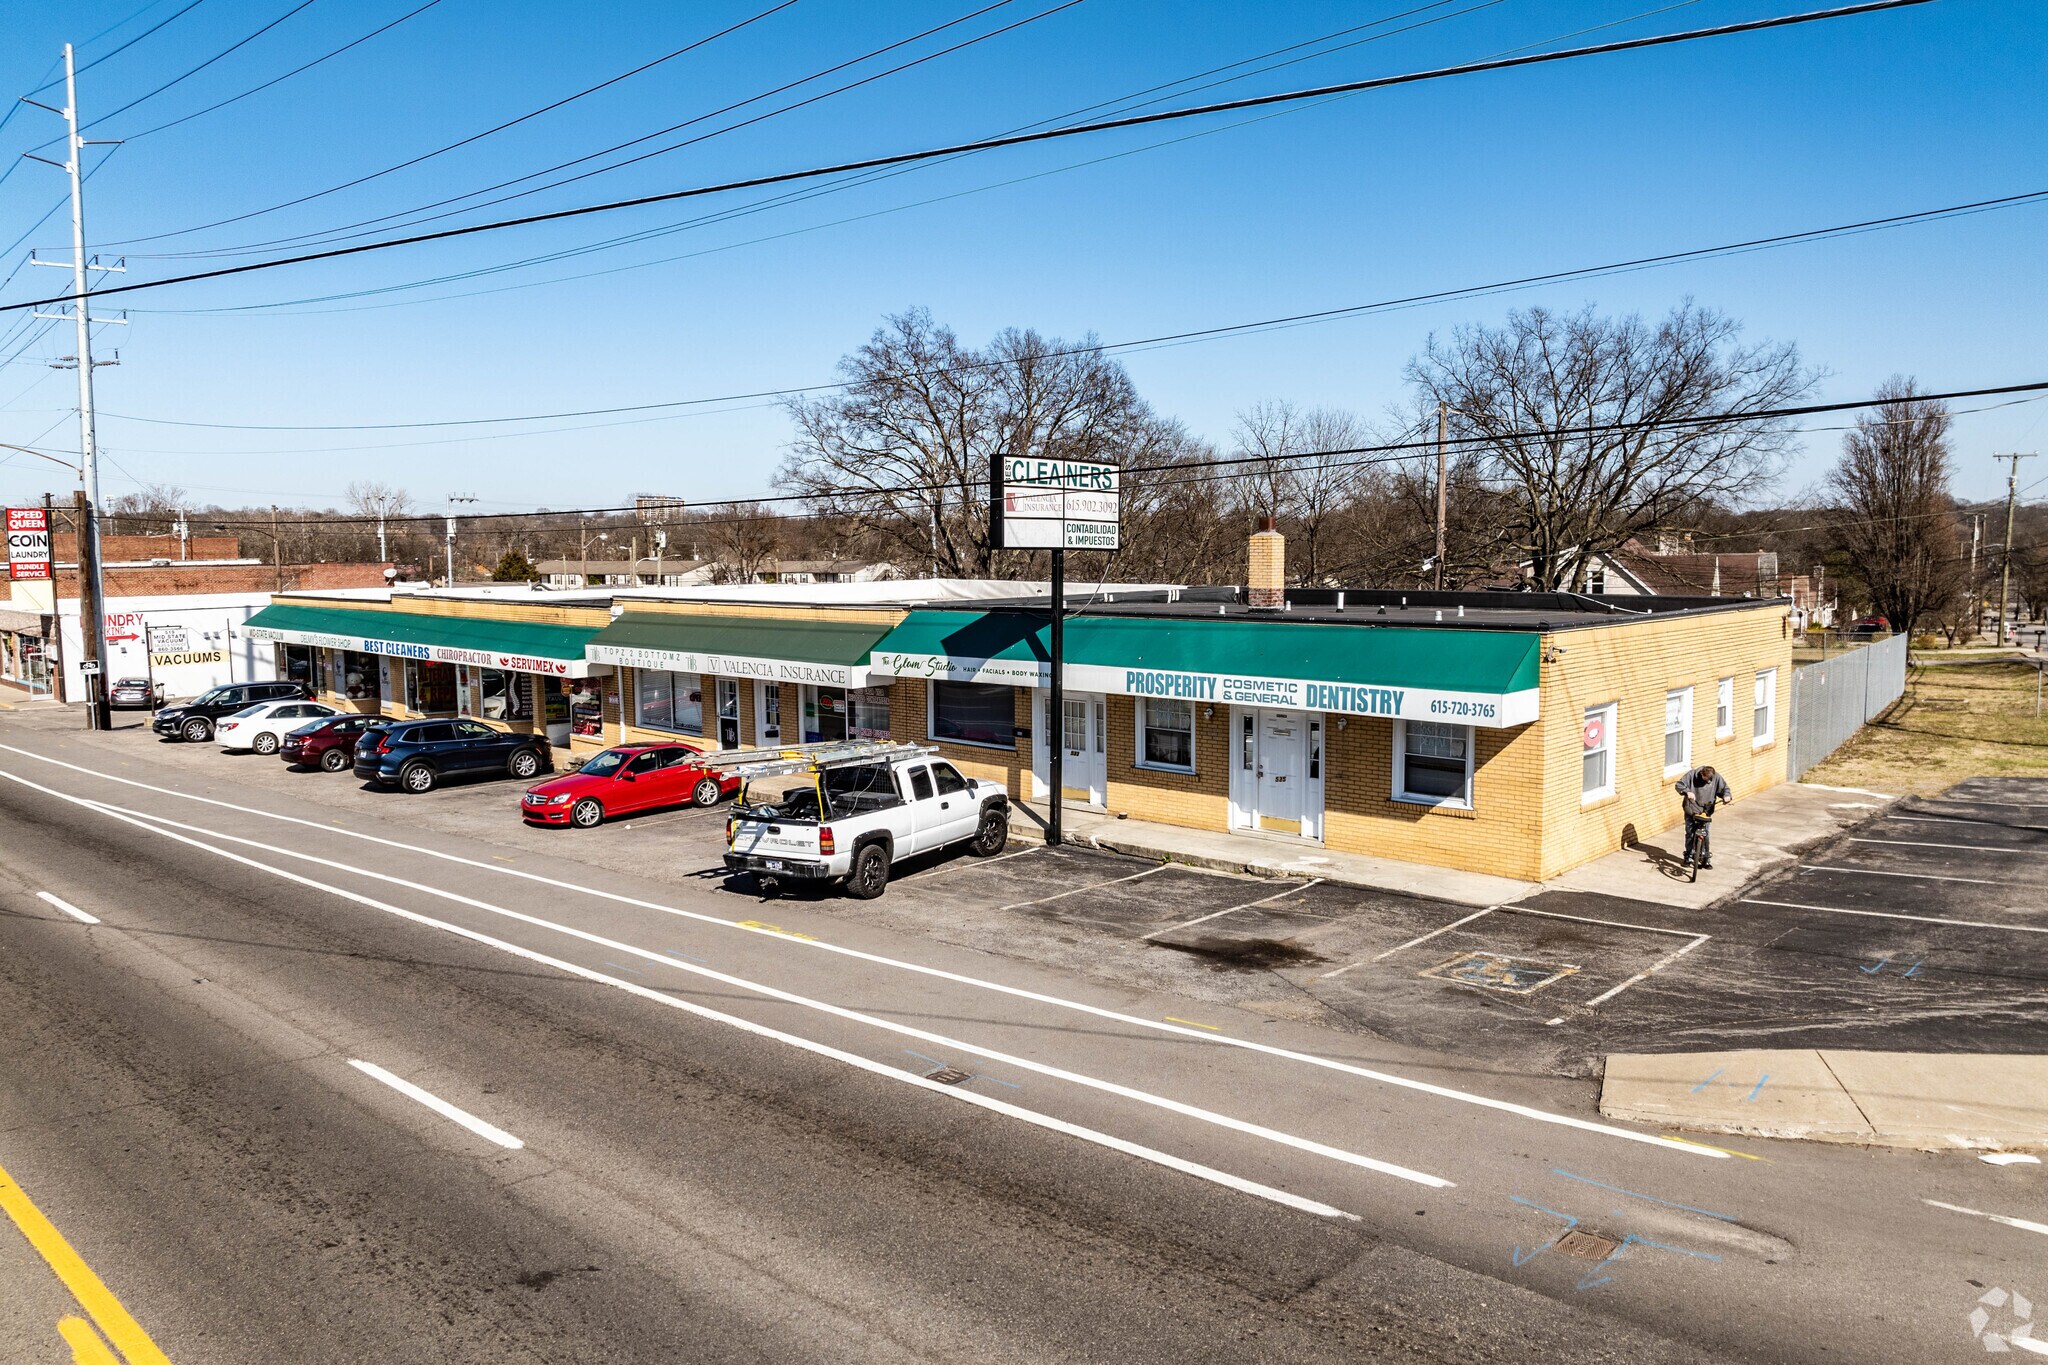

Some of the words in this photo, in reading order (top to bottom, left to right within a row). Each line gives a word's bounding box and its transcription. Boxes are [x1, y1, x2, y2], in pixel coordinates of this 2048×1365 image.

[1012, 460, 1112, 489] CLEANERS
[1024, 503, 1062, 512] INSURANCE
[1066, 499, 1118, 514] 615.902.3092
[11, 510, 43, 519] SPEED
[9, 519, 46, 529] QUEEN
[1066, 523, 1116, 535] CONTABILIDAD
[9, 535, 48, 547] COIN
[1075, 536, 1115, 546] IMPUESTOS
[104, 614, 143, 627] NDRY
[105, 627, 125, 636] KING
[154, 651, 221, 666] VACUUMS
[268, 630, 284, 640] VACUUM
[318, 637, 337, 647] FLOWER
[337, 638, 352, 648] SHOP
[364, 640, 384, 653] BEST
[386, 642, 430, 660] CLEANERS
[436, 648, 492, 665] CHIROPRACTOR
[511, 656, 554, 673] SERVIMEX
[604, 647, 625, 656] TOPZ
[629, 649, 633, 657] 2
[638, 650, 680, 661] BOTTOMZ
[619, 657, 664, 669] BOUTIQUE
[893, 654, 924, 676] Glam
[925, 656, 957, 677] Studio
[982, 667, 1005, 675] FACIALS
[1012, 669, 1028, 677] BODY
[723, 660, 774, 677] VALENCIA
[780, 665, 846, 684] INSURANCE
[1126, 671, 1217, 700] PROSPERITY
[1223, 678, 1298, 693] COSMETIC
[1234, 692, 1298, 706] GENERAL
[1306, 683, 1405, 716] DENTISTRY
[1430, 699, 1495, 718] 615-720-3765
[736, 834, 815, 848] CHEVROLET
